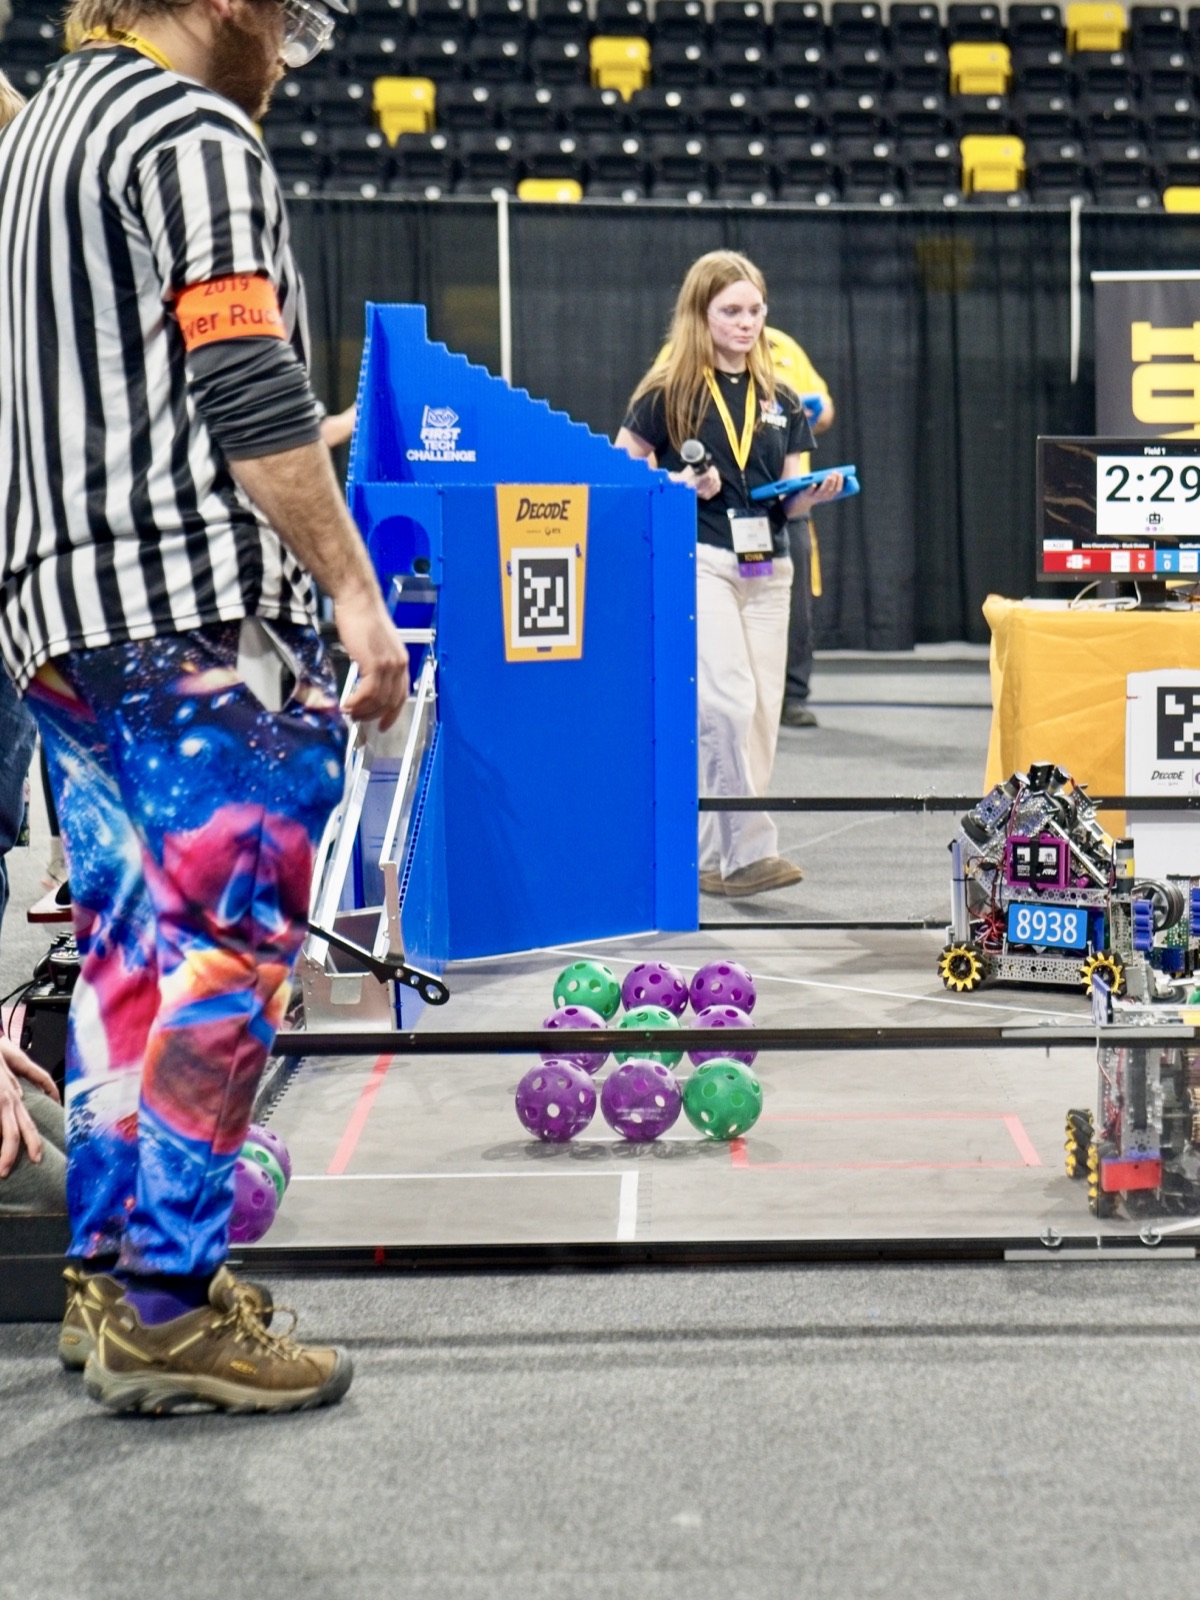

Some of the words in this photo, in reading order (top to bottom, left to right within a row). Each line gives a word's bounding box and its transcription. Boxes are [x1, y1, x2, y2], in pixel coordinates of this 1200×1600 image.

[420, 427, 461, 441] FIRST
[423, 440, 456, 451] TECH
[406, 450, 476, 462] CHALLENGE
[516, 498, 571, 522] DECODE
[1151, 770, 1185, 781] DECODE
[1015, 908, 1078, 943] 8938
